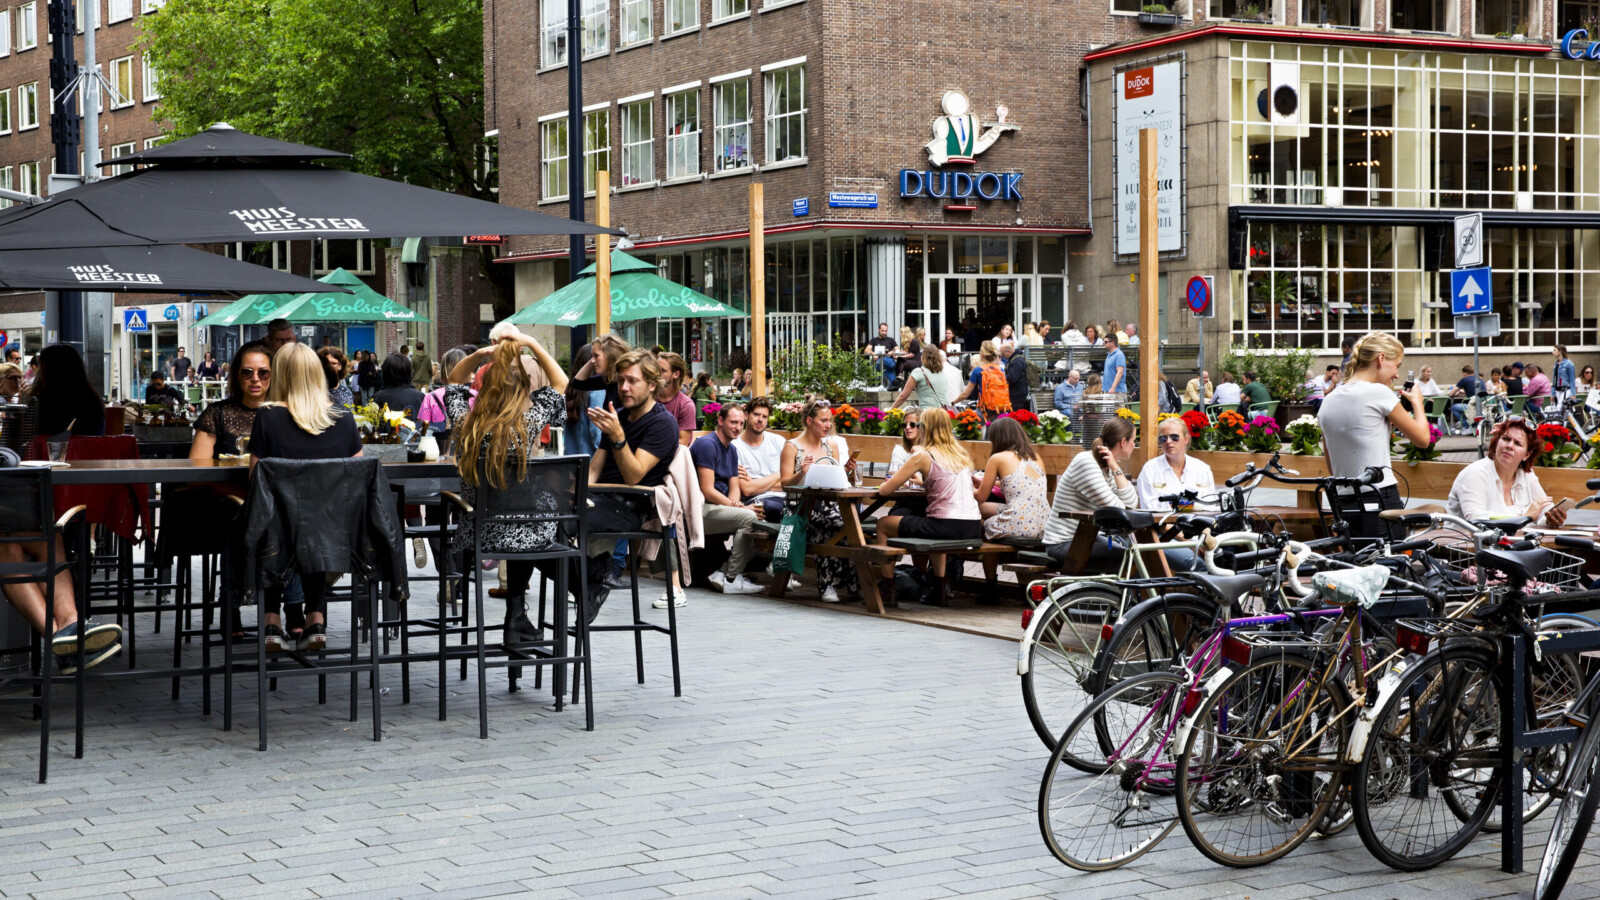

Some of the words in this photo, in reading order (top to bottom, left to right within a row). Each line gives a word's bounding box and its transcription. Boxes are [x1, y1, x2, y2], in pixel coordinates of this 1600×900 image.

[1128, 77, 1150, 89] DUDOK
[899, 168, 1024, 200] DUDOK
[229, 206, 296, 220] HUIS
[243, 217, 366, 232] MEESTER
[67, 264, 114, 273] HUIS
[74, 272, 161, 282] MEESTER
[310, 297, 396, 316] Grolsch
[610, 287, 697, 315] Grolsch
[382, 310, 415, 319] Grolsch
[686, 303, 726, 313] Grolsch
